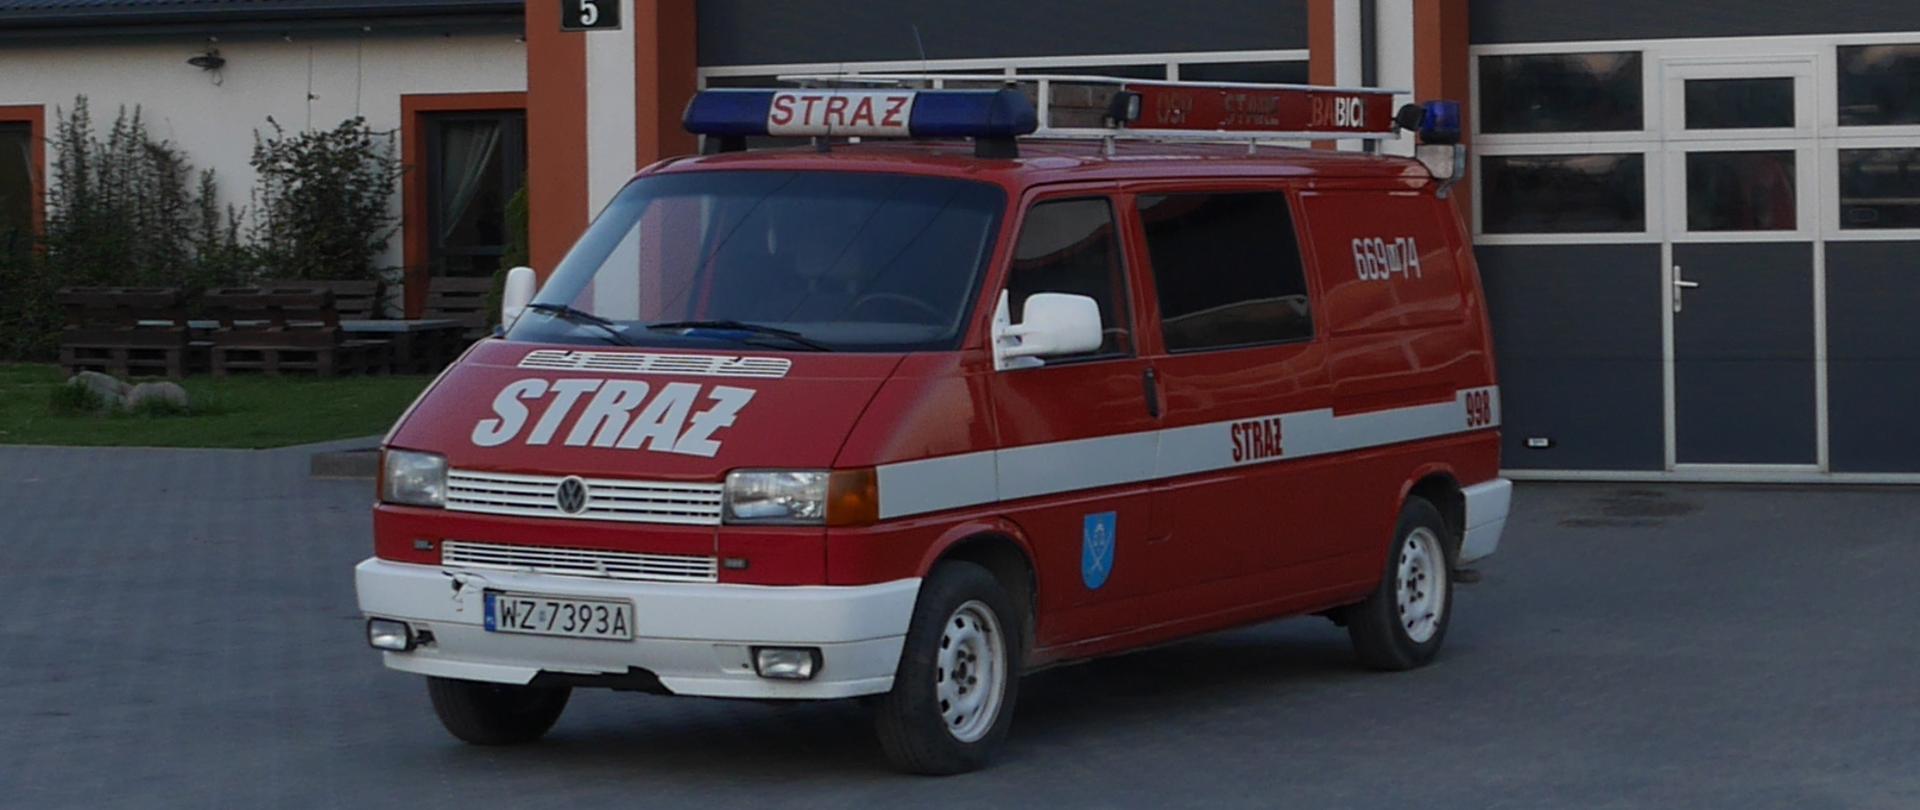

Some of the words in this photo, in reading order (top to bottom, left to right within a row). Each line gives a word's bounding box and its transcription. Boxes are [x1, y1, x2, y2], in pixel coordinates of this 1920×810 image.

[580, 0, 598, 26] 5
[1466, 389, 1491, 427] 998
[546, 602, 627, 636] 7393A
